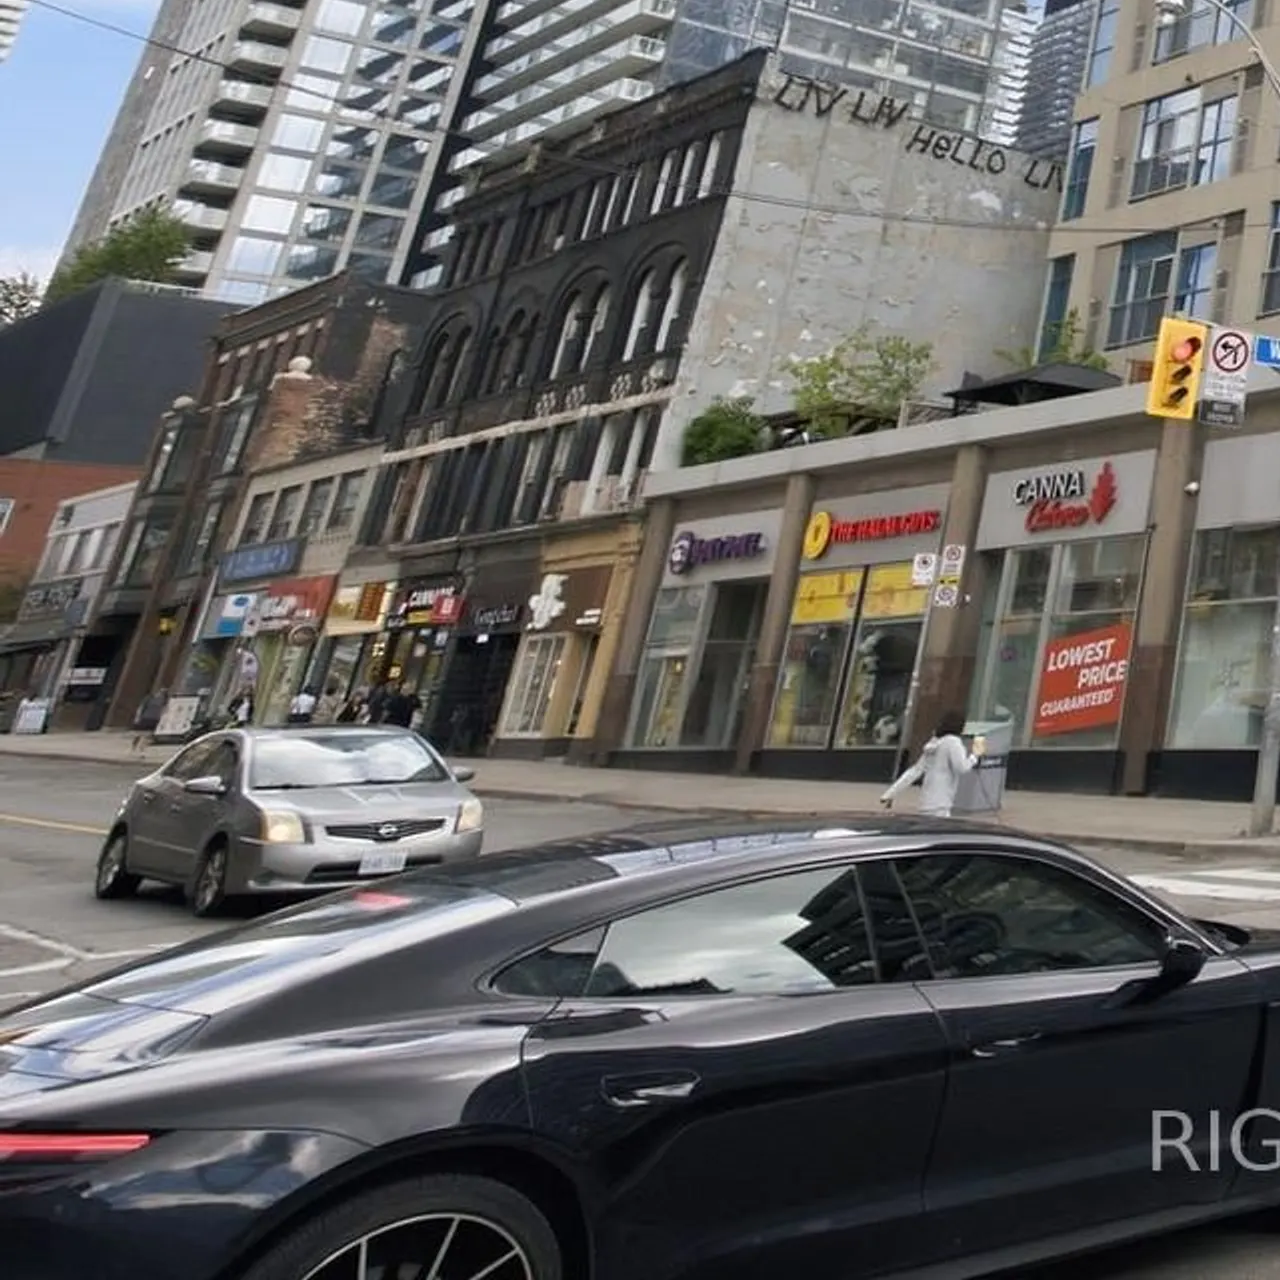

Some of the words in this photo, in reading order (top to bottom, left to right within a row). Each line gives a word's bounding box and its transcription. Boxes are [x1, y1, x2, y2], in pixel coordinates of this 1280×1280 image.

[1012, 471, 1085, 505] CANNA
[1047, 637, 1116, 673] LOWEST
[1077, 659, 1128, 689] PRICE
[1039, 688, 1115, 718] GUARANTEED
